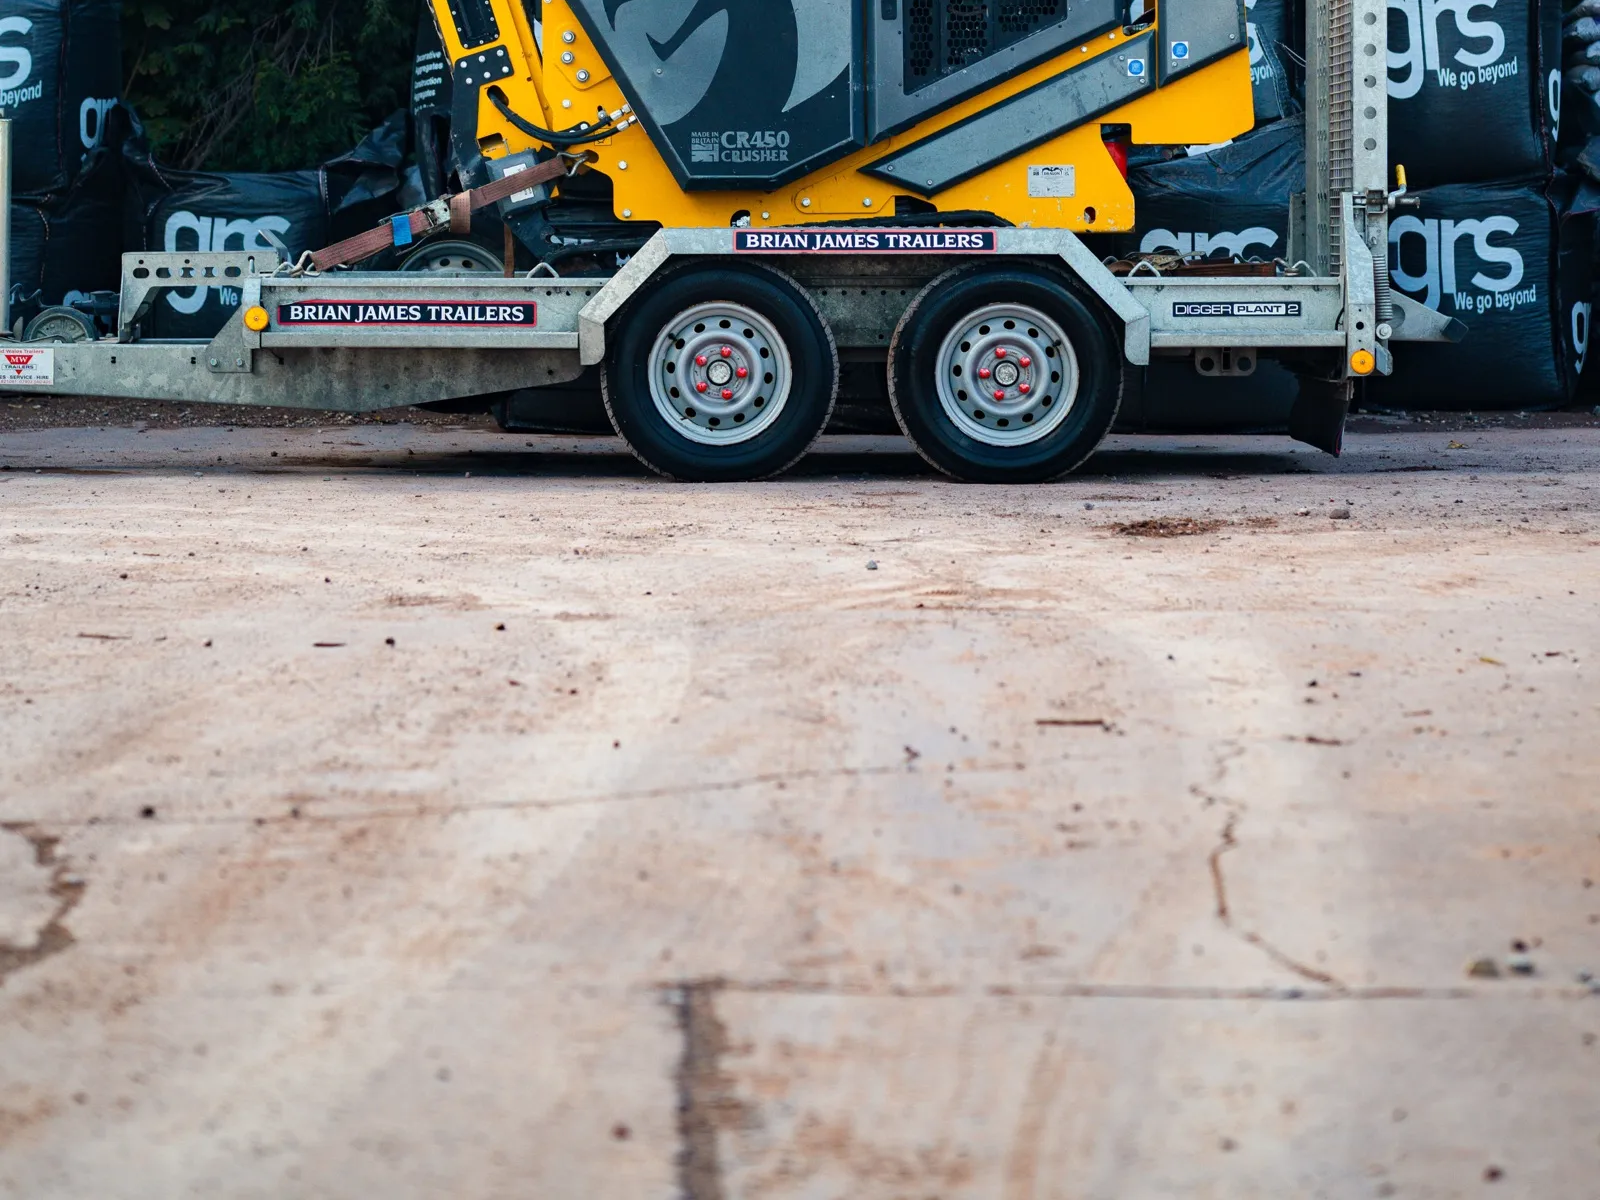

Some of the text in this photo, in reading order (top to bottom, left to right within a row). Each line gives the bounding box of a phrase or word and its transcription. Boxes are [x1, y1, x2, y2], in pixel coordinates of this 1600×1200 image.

[1437, 56, 1518, 90] We go beyond
[721, 130, 790, 148] CR450
[721, 150, 789, 162] CRUSHER
[746, 234, 984, 250] BRIAN JAMES TRAILERS
[1388, 215, 1524, 311] grs
[219, 288, 238, 306] We
[1454, 284, 1536, 314] We go beyond
[290, 305, 525, 323] BRIAN JAMES TRAILERS
[1175, 304, 1299, 315] DIGGER PLANT 2
